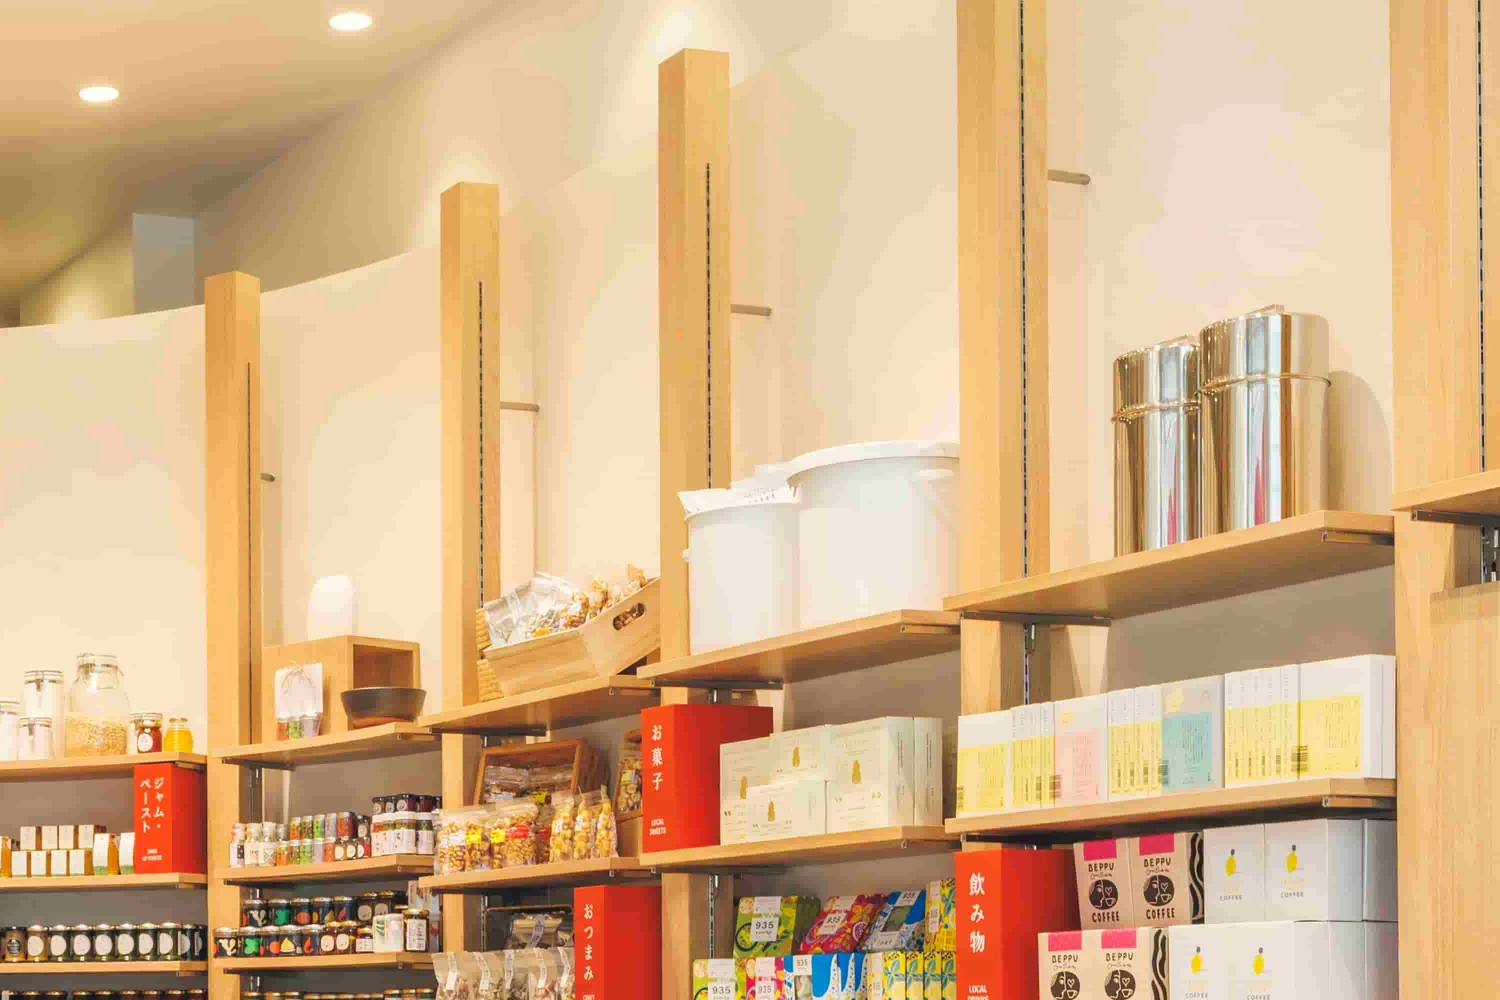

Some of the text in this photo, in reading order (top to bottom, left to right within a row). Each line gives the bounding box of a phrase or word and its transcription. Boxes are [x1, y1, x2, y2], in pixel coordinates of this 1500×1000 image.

[651, 725, 663, 791] お菓子
[140, 779, 152, 834] ペースト
[1088, 863, 1115, 872] BEPPU
[1143, 857, 1171, 868] BEPPU
[969, 873, 985, 953] 飲み物
[1091, 911, 1120, 923] COFFEE
[1146, 908, 1175, 920] COFFEE
[755, 921, 774, 930] 935
[583, 904, 595, 981] おつまみ
[1051, 955, 1079, 963] BEPPU
[1105, 952, 1134, 961] BEPPU
[712, 986, 731, 995] 935
[969, 985, 988, 994] LOCAL
